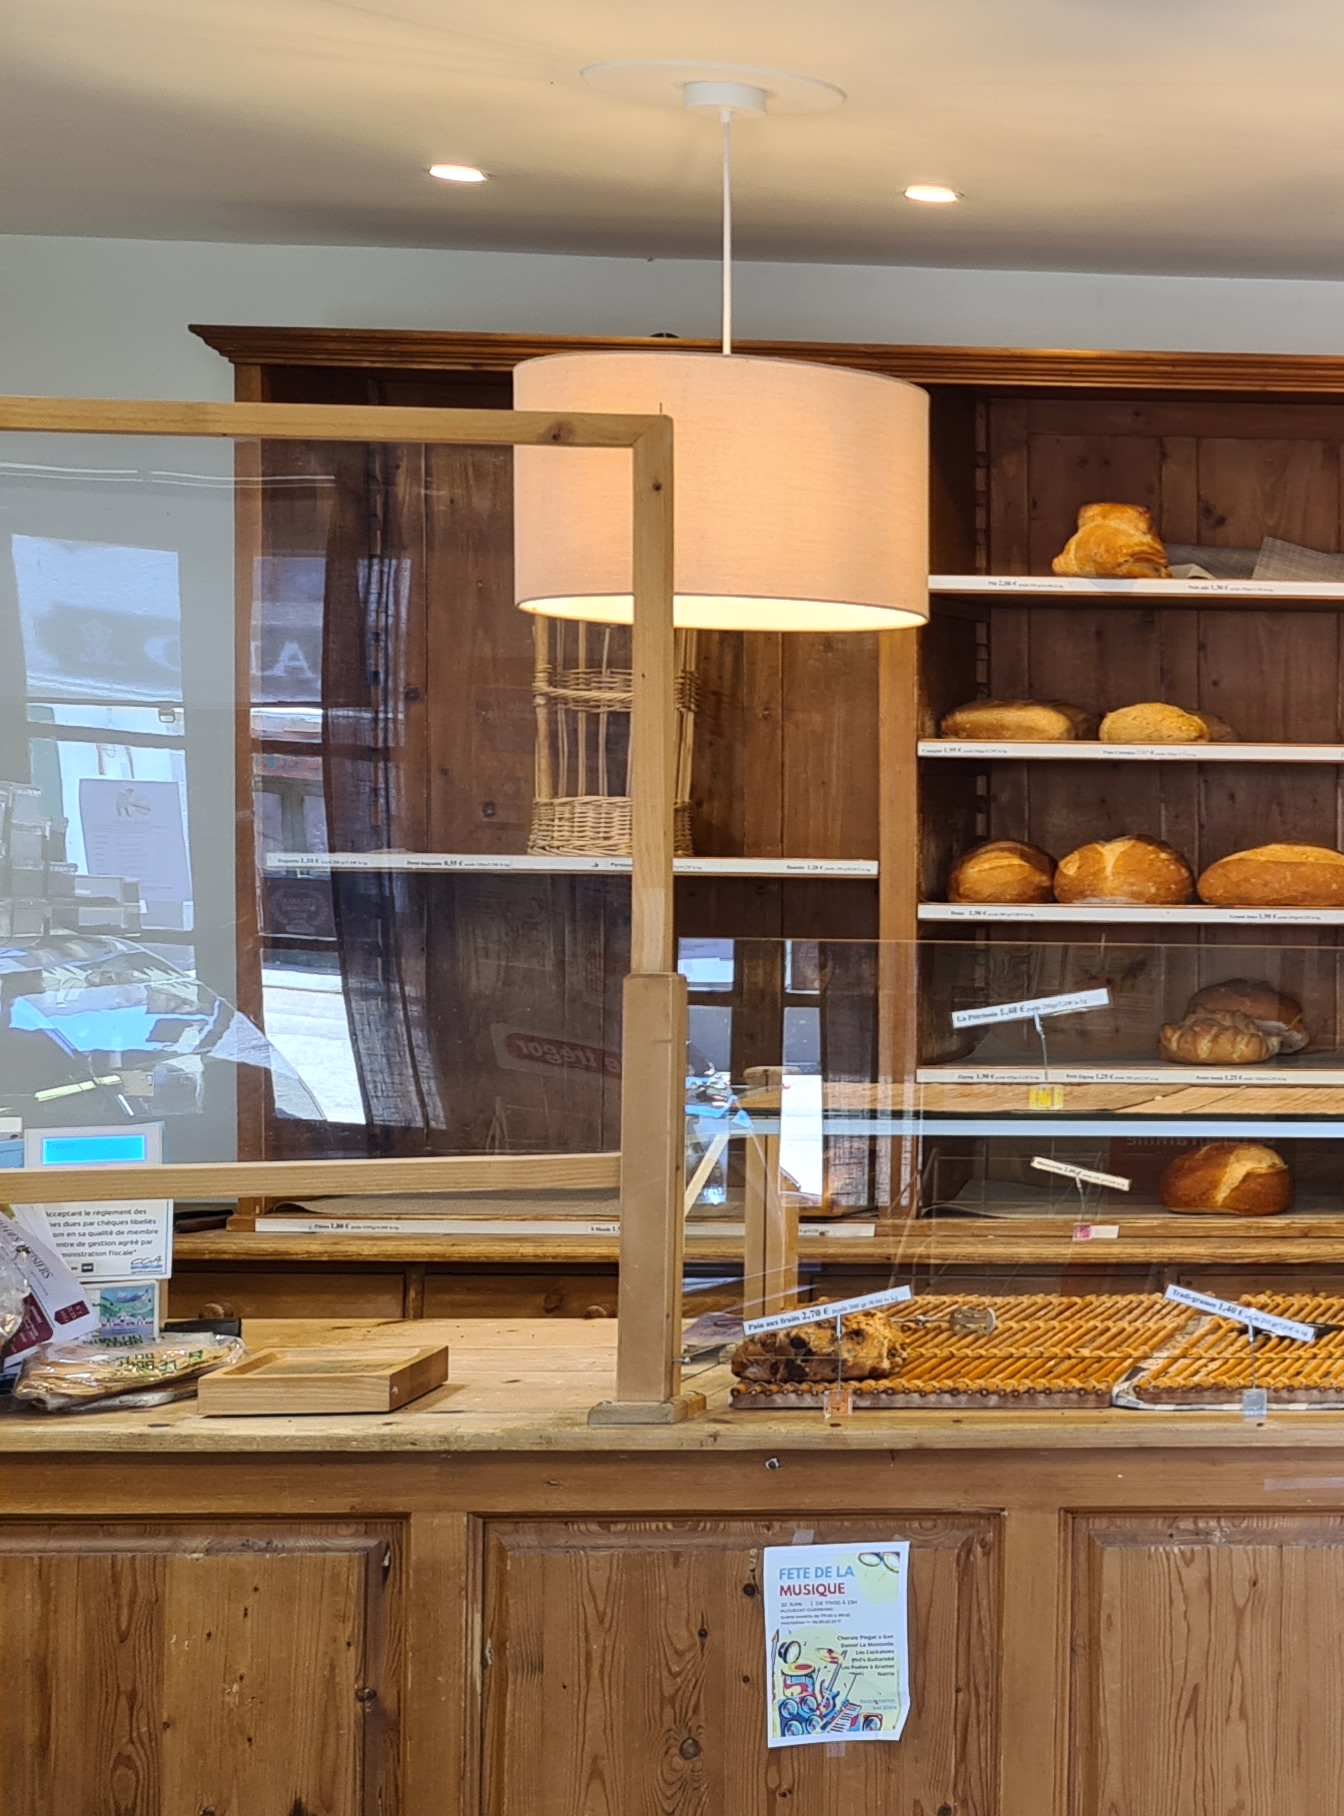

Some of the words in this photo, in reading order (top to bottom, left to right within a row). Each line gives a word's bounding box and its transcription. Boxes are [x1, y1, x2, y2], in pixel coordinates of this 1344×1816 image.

[83, 1221, 96, 1229] par
[115, 1228, 125, 1236] de
[126, 1228, 159, 1236] membre
[76, 1240, 86, 1248] de
[88, 1240, 117, 1250] gestion
[141, 1238, 153, 1247] par
[779, 1567, 811, 1580] FETE
[815, 1565, 832, 1579] DE
[836, 1565, 855, 1578] LA
[779, 1582, 846, 1597] MUSIQUE
